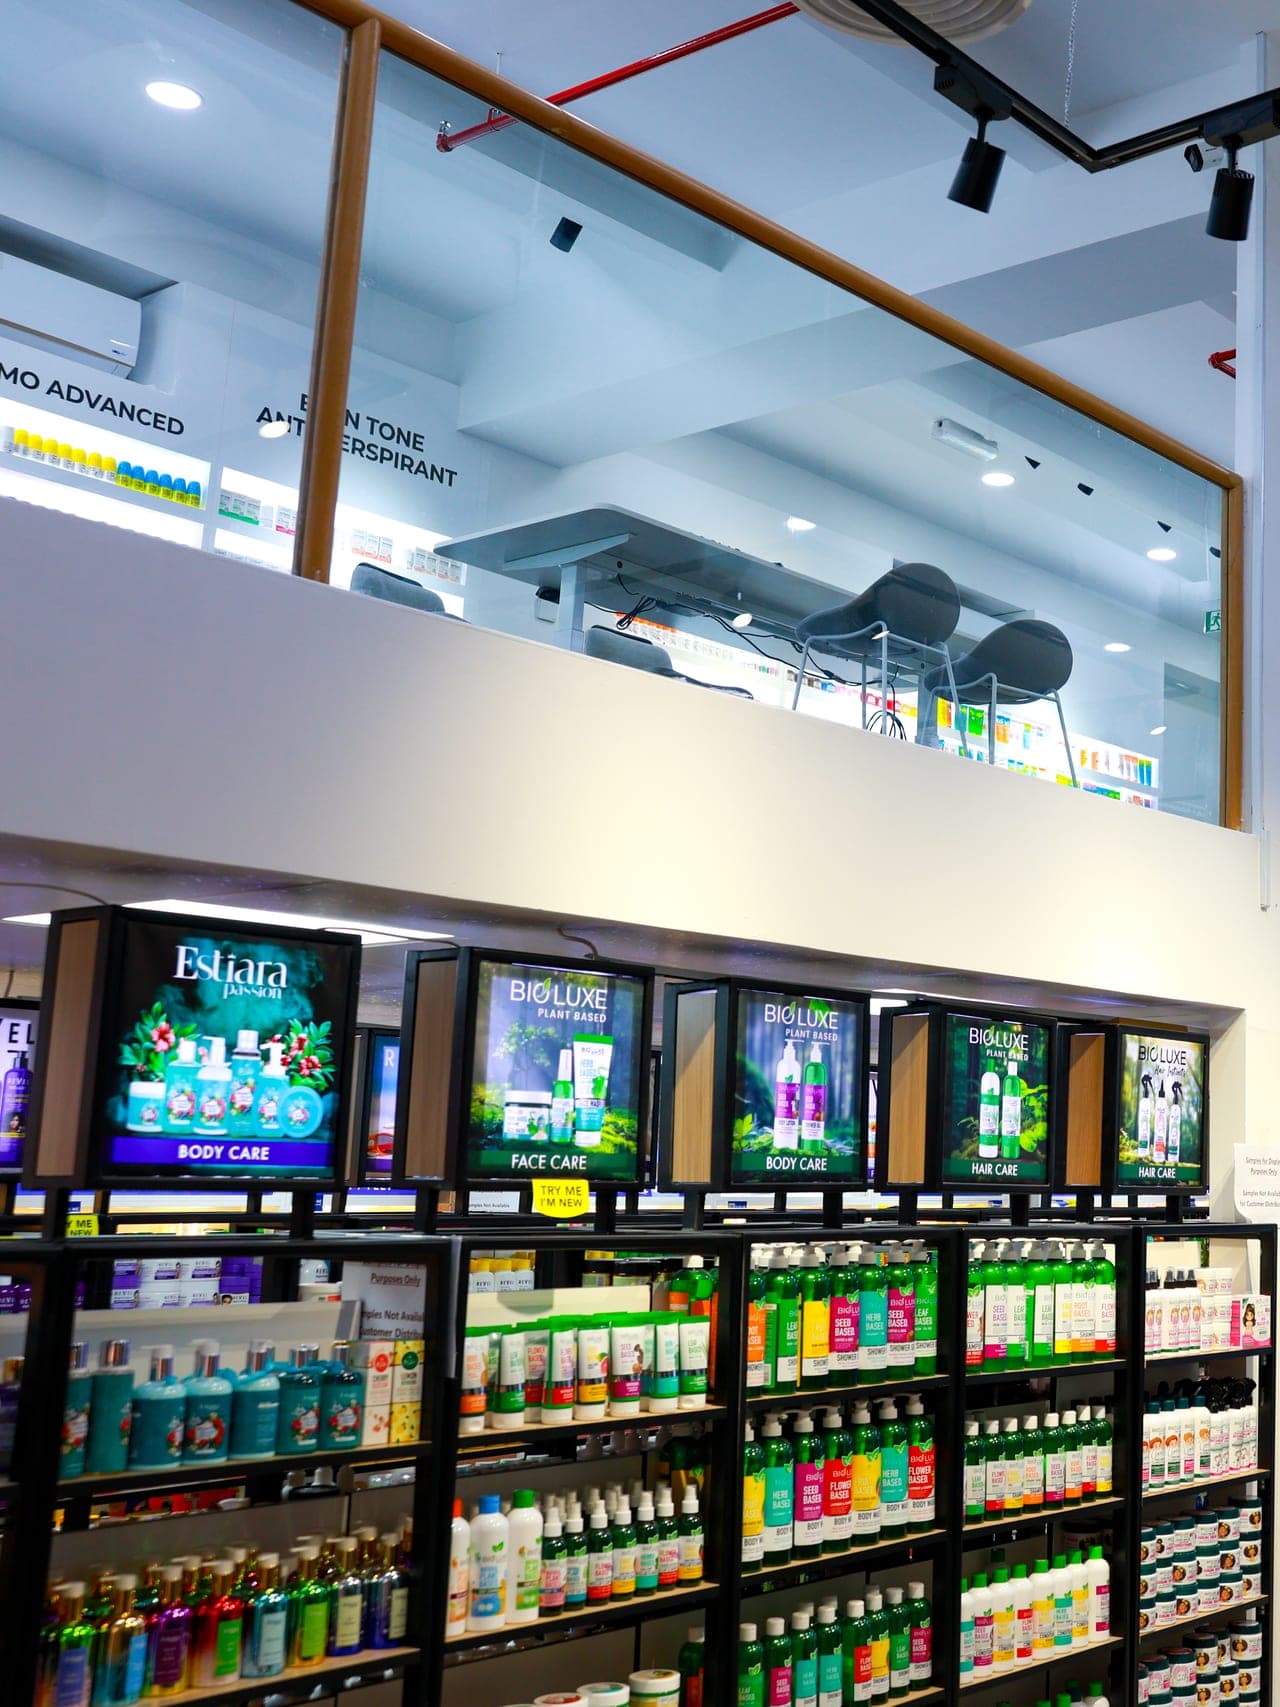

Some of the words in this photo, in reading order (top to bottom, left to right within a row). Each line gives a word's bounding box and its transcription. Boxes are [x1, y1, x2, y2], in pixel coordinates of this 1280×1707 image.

[46, 380, 184, 435] ADVANCED
[366, 416, 425, 452] TONE
[172, 945, 288, 988] Estiara
[223, 983, 282, 999] passion
[537, 1008, 570, 1019] PLANT
[573, 1011, 607, 1023] BASED
[785, 1028, 810, 1038] PLANT
[812, 1031, 838, 1041] BASED
[986, 1048, 1006, 1058] PLANT
[178, 1144, 224, 1159] BODY
[228, 1146, 270, 1160] CARE
[511, 1154, 546, 1169] FACE
[550, 1155, 587, 1170] CARE
[766, 1156, 797, 1170] BODY
[800, 1157, 828, 1171] CARE
[972, 1163, 993, 1175] HAIR
[996, 1164, 1018, 1176] CARE
[1138, 1167, 1155, 1177] HAIR
[1157, 1168, 1176, 1178] CARE
[540, 1185, 560, 1195] TRY
[565, 1186, 583, 1196] ME
[540, 1196, 556, 1207] I'M
[558, 1197, 583, 1208] NEW
